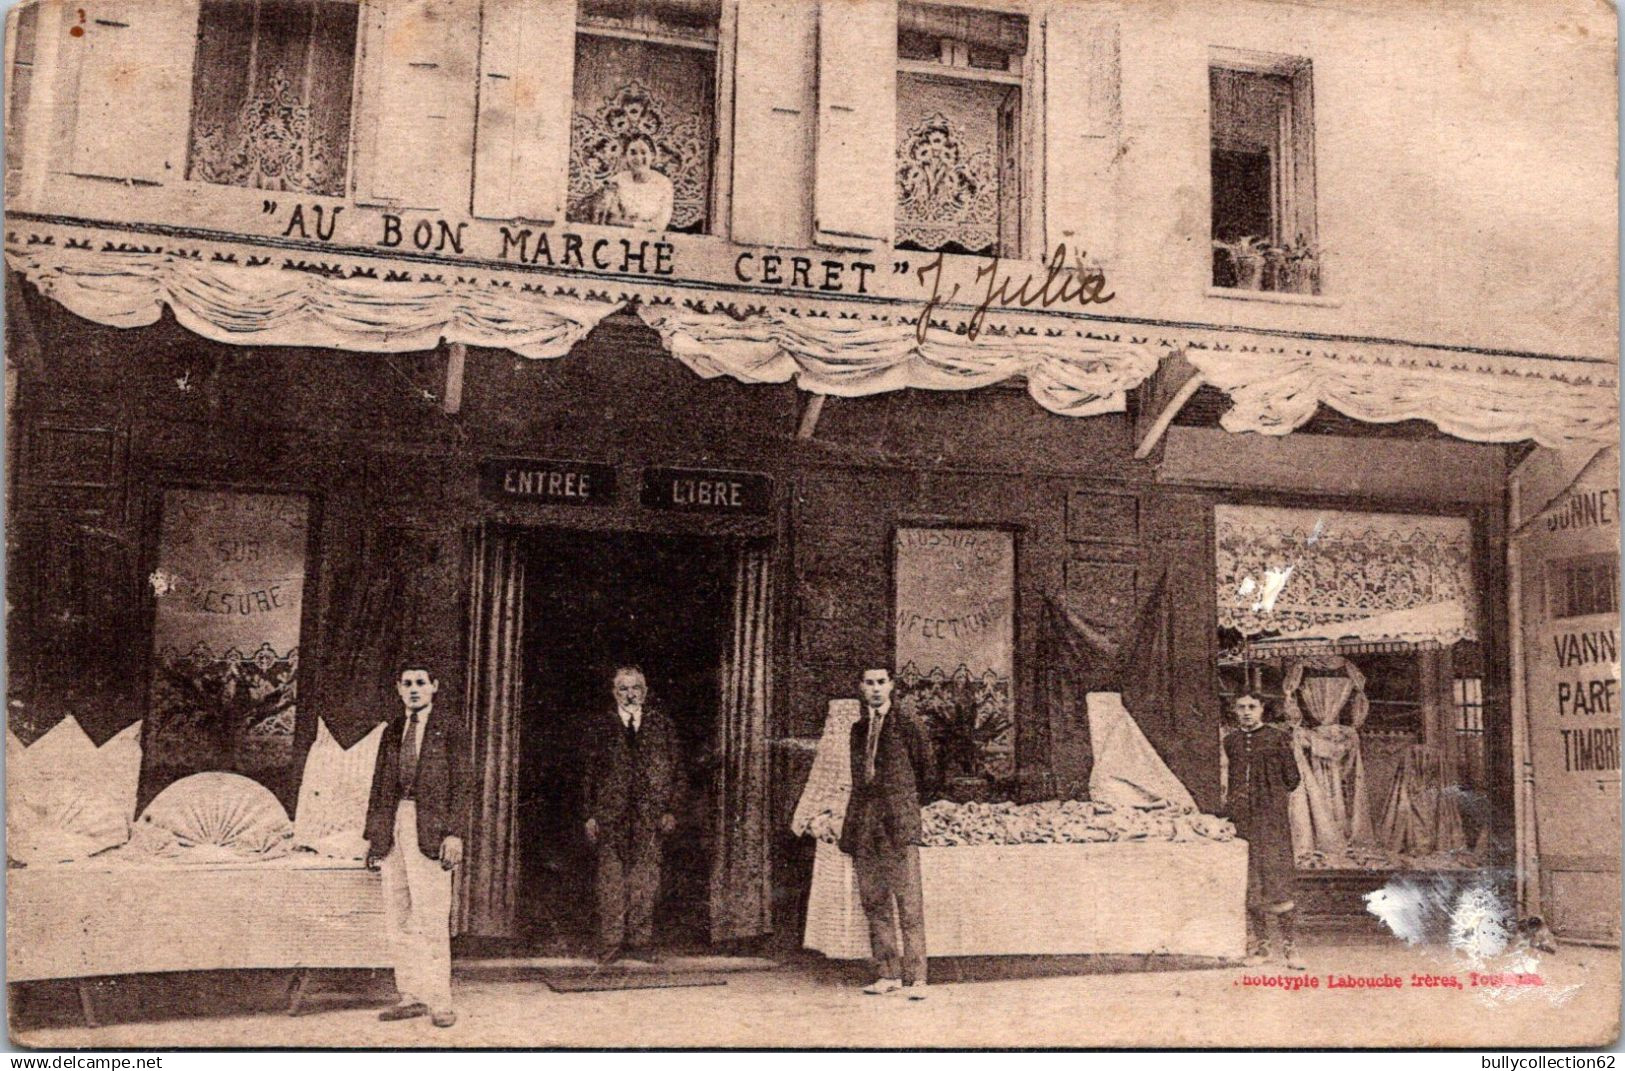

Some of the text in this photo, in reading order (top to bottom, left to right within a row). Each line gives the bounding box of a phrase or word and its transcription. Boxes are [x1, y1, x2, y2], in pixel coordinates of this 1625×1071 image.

[377, 214, 468, 254] BON
[672, 480, 743, 506] LIBRE
[1554, 630, 1617, 669] VANN
[1558, 679, 1617, 717] PARF
